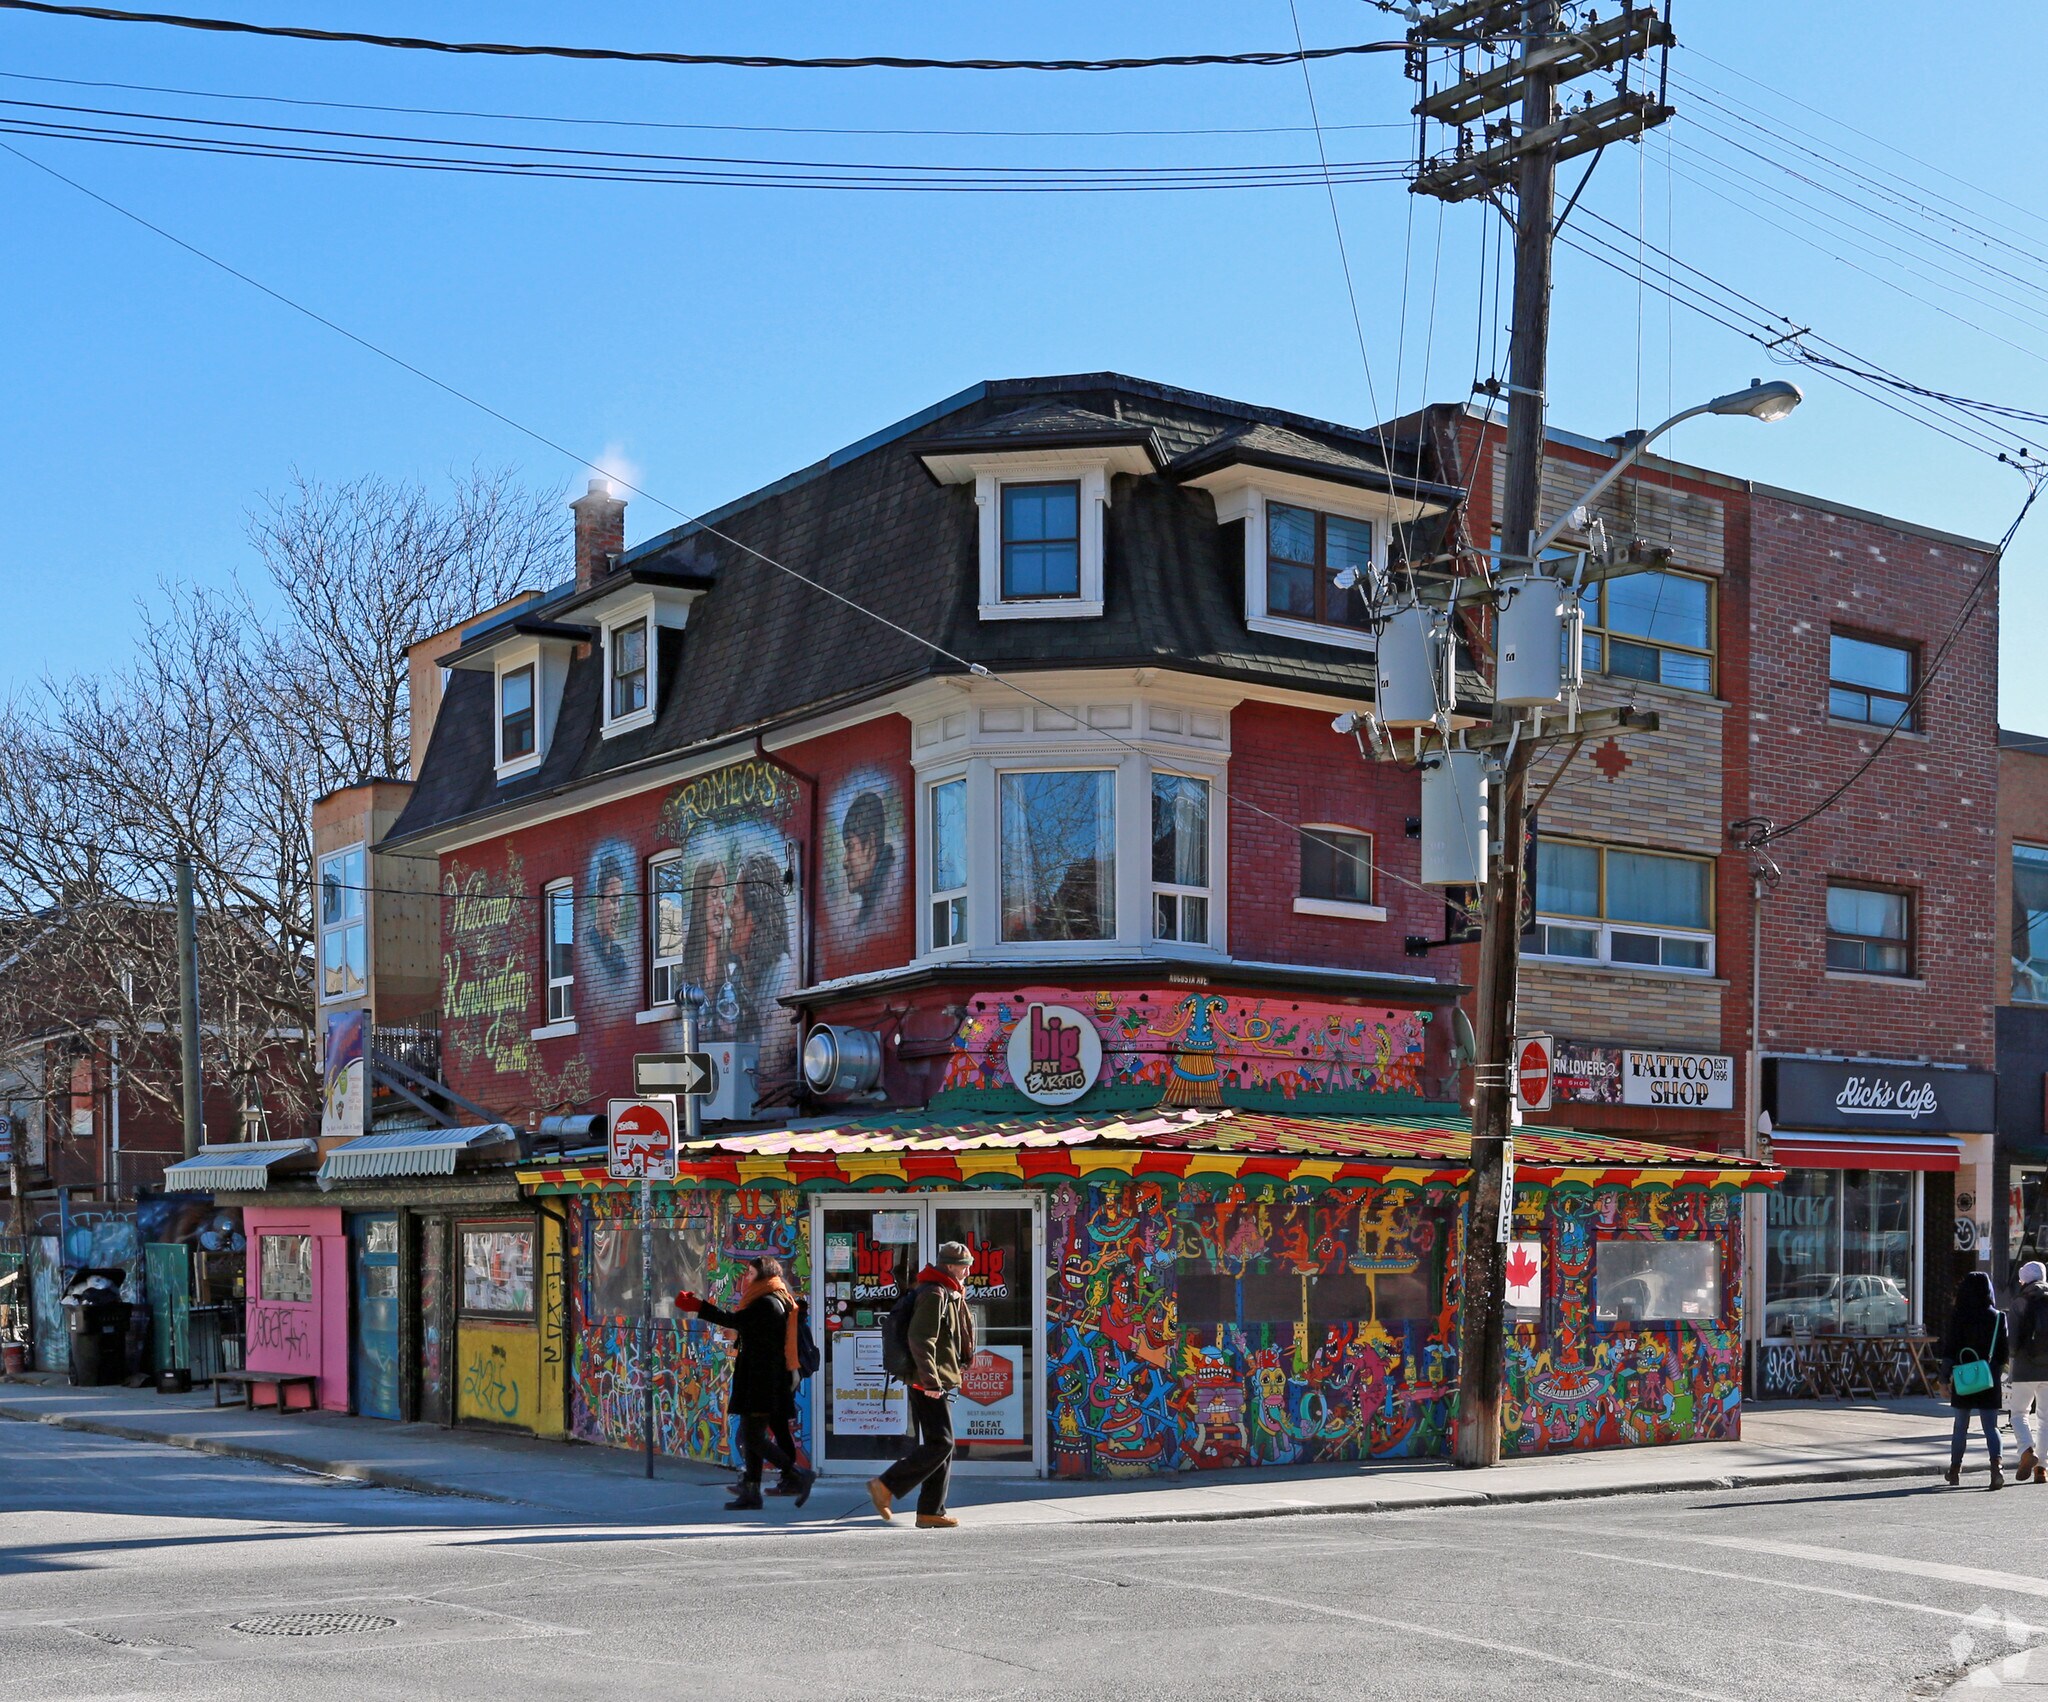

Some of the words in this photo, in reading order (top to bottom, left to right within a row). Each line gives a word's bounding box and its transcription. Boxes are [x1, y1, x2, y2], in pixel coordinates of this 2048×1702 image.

[443, 868, 510, 934] Welcome
[1169, 974, 1196, 984] AUGUSTA
[443, 950, 527, 1059] Kensington
[1031, 1006, 1081, 1074] big
[1032, 1061, 1060, 1073] FAT
[1569, 1059, 1606, 1077] LOVERS
[1630, 1053, 1713, 1080] TATTOO
[1713, 1070, 1728, 1081] 1996
[1650, 1081, 1710, 1105] SHOP
[1836, 1076, 1895, 1108] Rick's
[1896, 1080, 1937, 1119] Cafe
[1503, 1166, 1512, 1235] LOVE
[829, 1238, 848, 1246] PASS
[857, 1231, 894, 1286] big
[967, 1231, 1004, 1286] big
[858, 1275, 879, 1286] FAT
[967, 1276, 989, 1286] FAT
[962, 1372, 1009, 1381] READER'S
[967, 1381, 1005, 1390] CHOICE
[836, 1388, 867, 1400] Social
[970, 1420, 985, 1428] BIG
[987, 1420, 1001, 1428] FAT
[967, 1428, 1005, 1436] BURRITO
